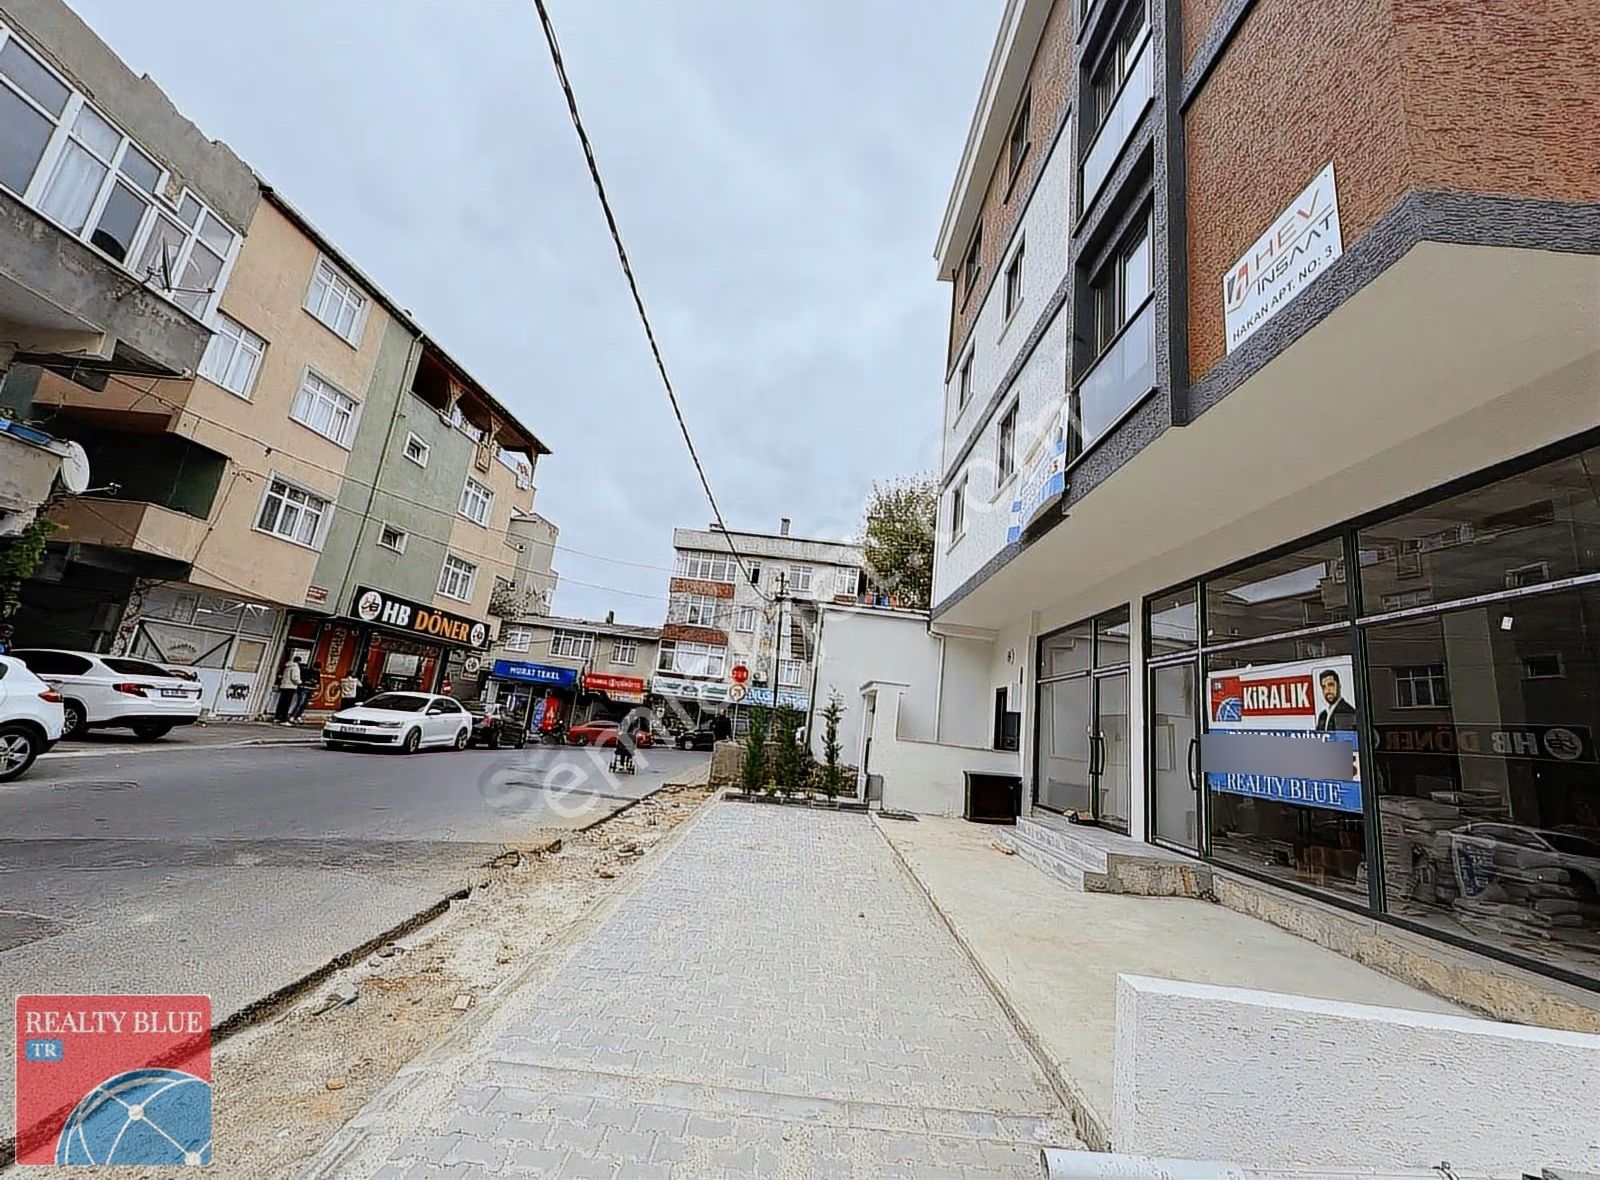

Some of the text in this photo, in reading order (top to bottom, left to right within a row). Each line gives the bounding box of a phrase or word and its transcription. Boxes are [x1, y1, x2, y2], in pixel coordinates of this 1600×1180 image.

[1255, 189, 1320, 270] HEV
[1232, 245, 1333, 342] HAKAN APT. NO: 3
[381, 600, 470, 641] HB DÖNER
[509, 666, 561, 680] MURAT TEKEL
[1226, 773, 1342, 805] REALTY BLUE
